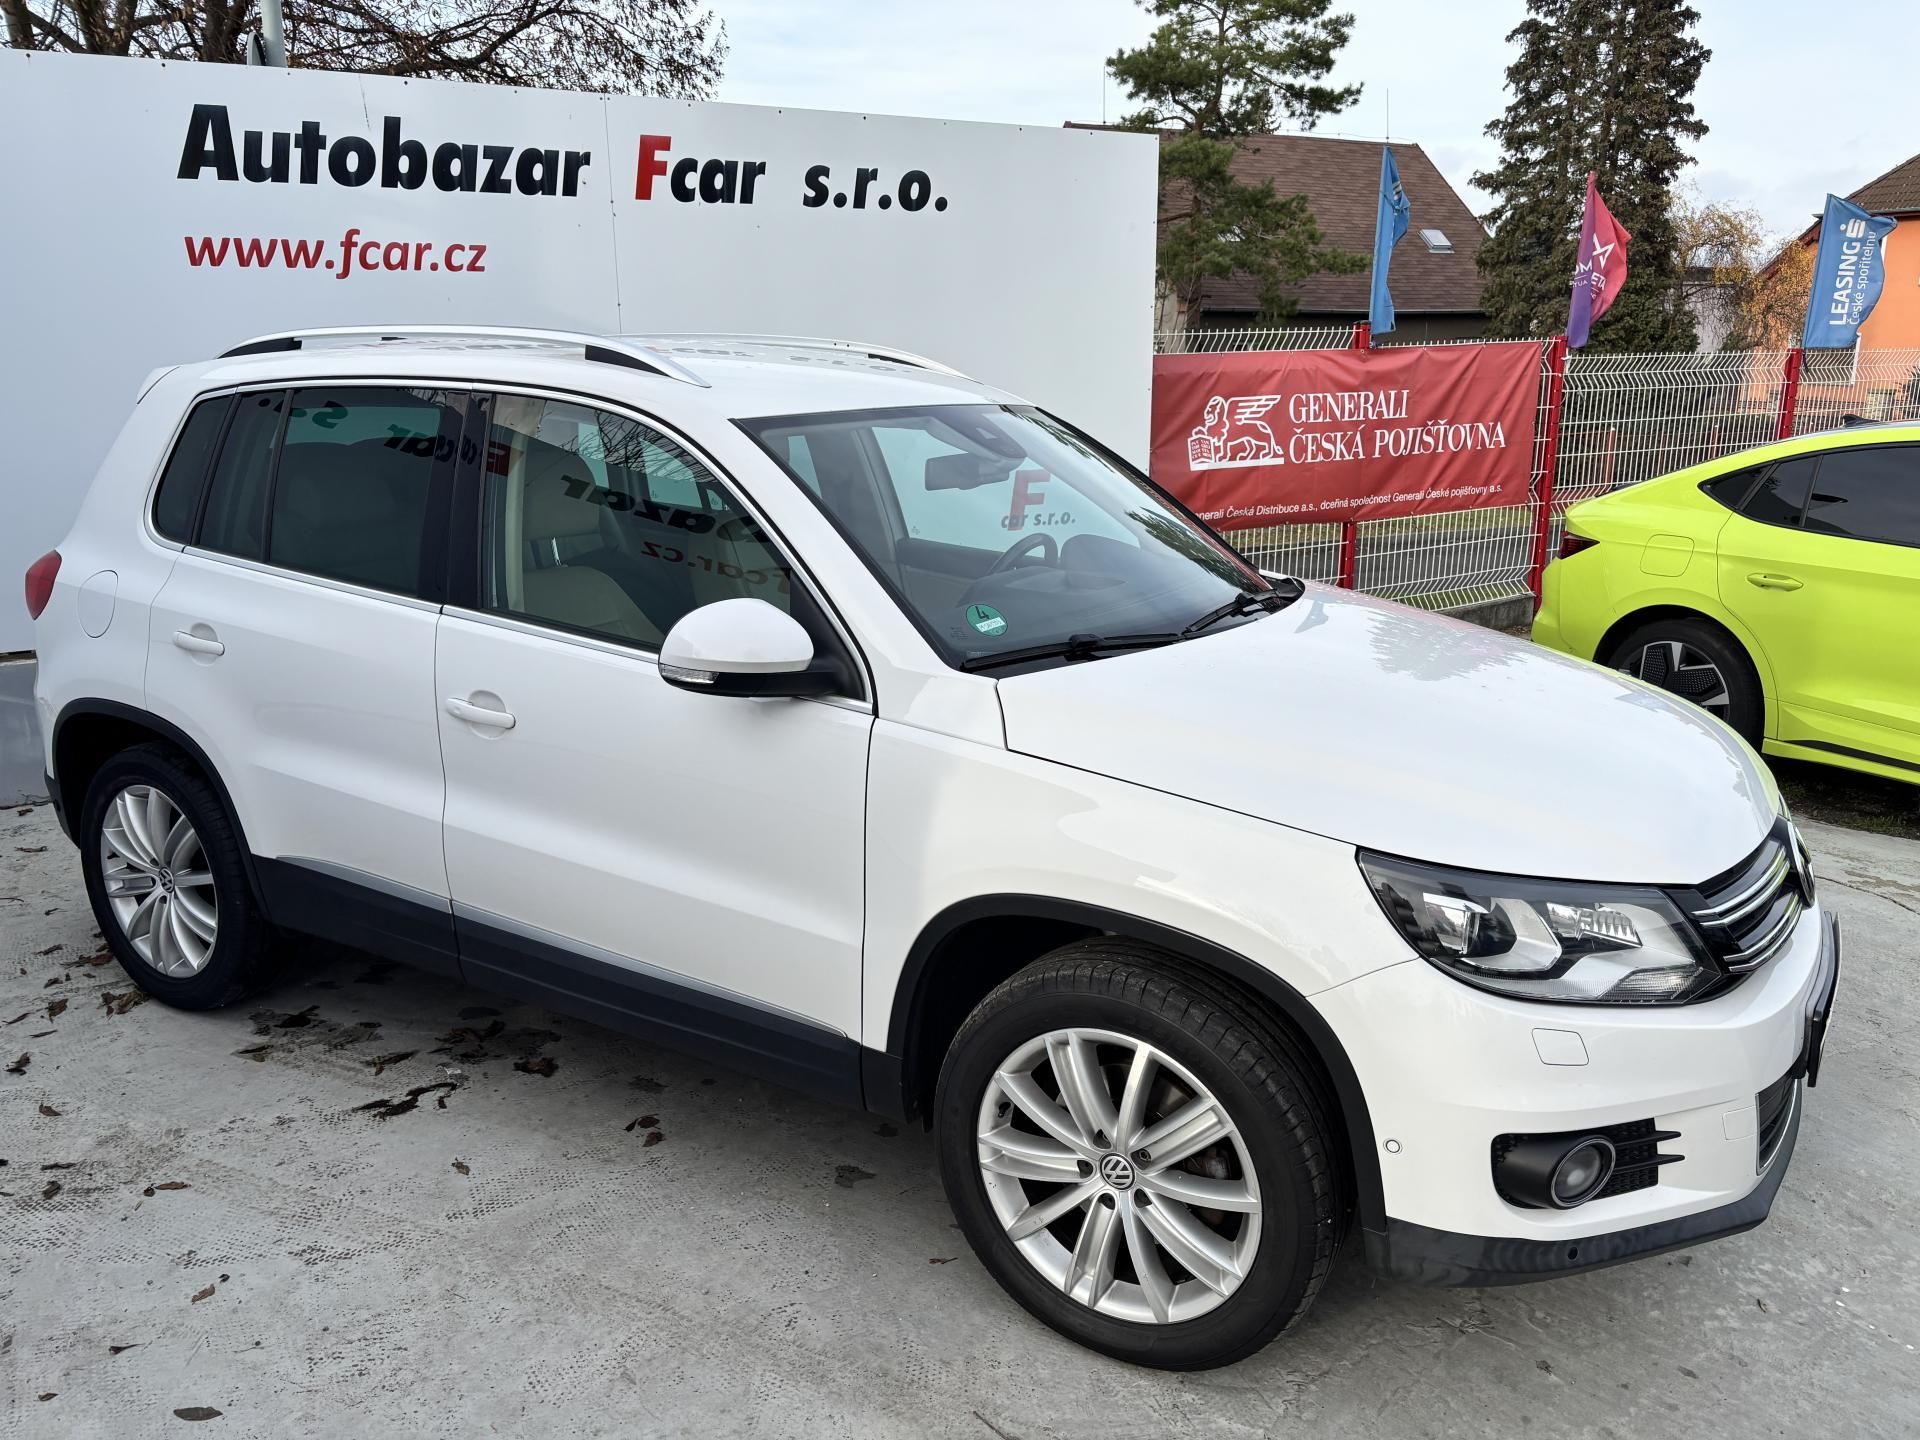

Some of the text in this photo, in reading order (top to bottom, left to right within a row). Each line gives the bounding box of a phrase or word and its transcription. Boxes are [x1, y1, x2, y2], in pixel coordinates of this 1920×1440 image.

[176, 103, 949, 212] Autobazar Fcar s.r.o.
[183, 227, 488, 280] www.fcar.cz
[1829, 241, 1861, 325] LEASING
[1846, 291, 1865, 325] České
[1288, 389, 1410, 424] GENERALI
[1288, 417, 1507, 465] ČESKÁ POJIŠŤOVNA
[1033, 511, 1076, 526] s.r.o.
[1226, 505, 1255, 518] Česká
[1255, 502, 1300, 516] Distribuce
[1301, 502, 1318, 513] a.s.,
[1349, 493, 1391, 508] společnost
[1392, 490, 1425, 503] Generali
[1425, 488, 1450, 500] České
[1489, 484, 1503, 494] a.s.
[974, 605, 990, 620] 4
